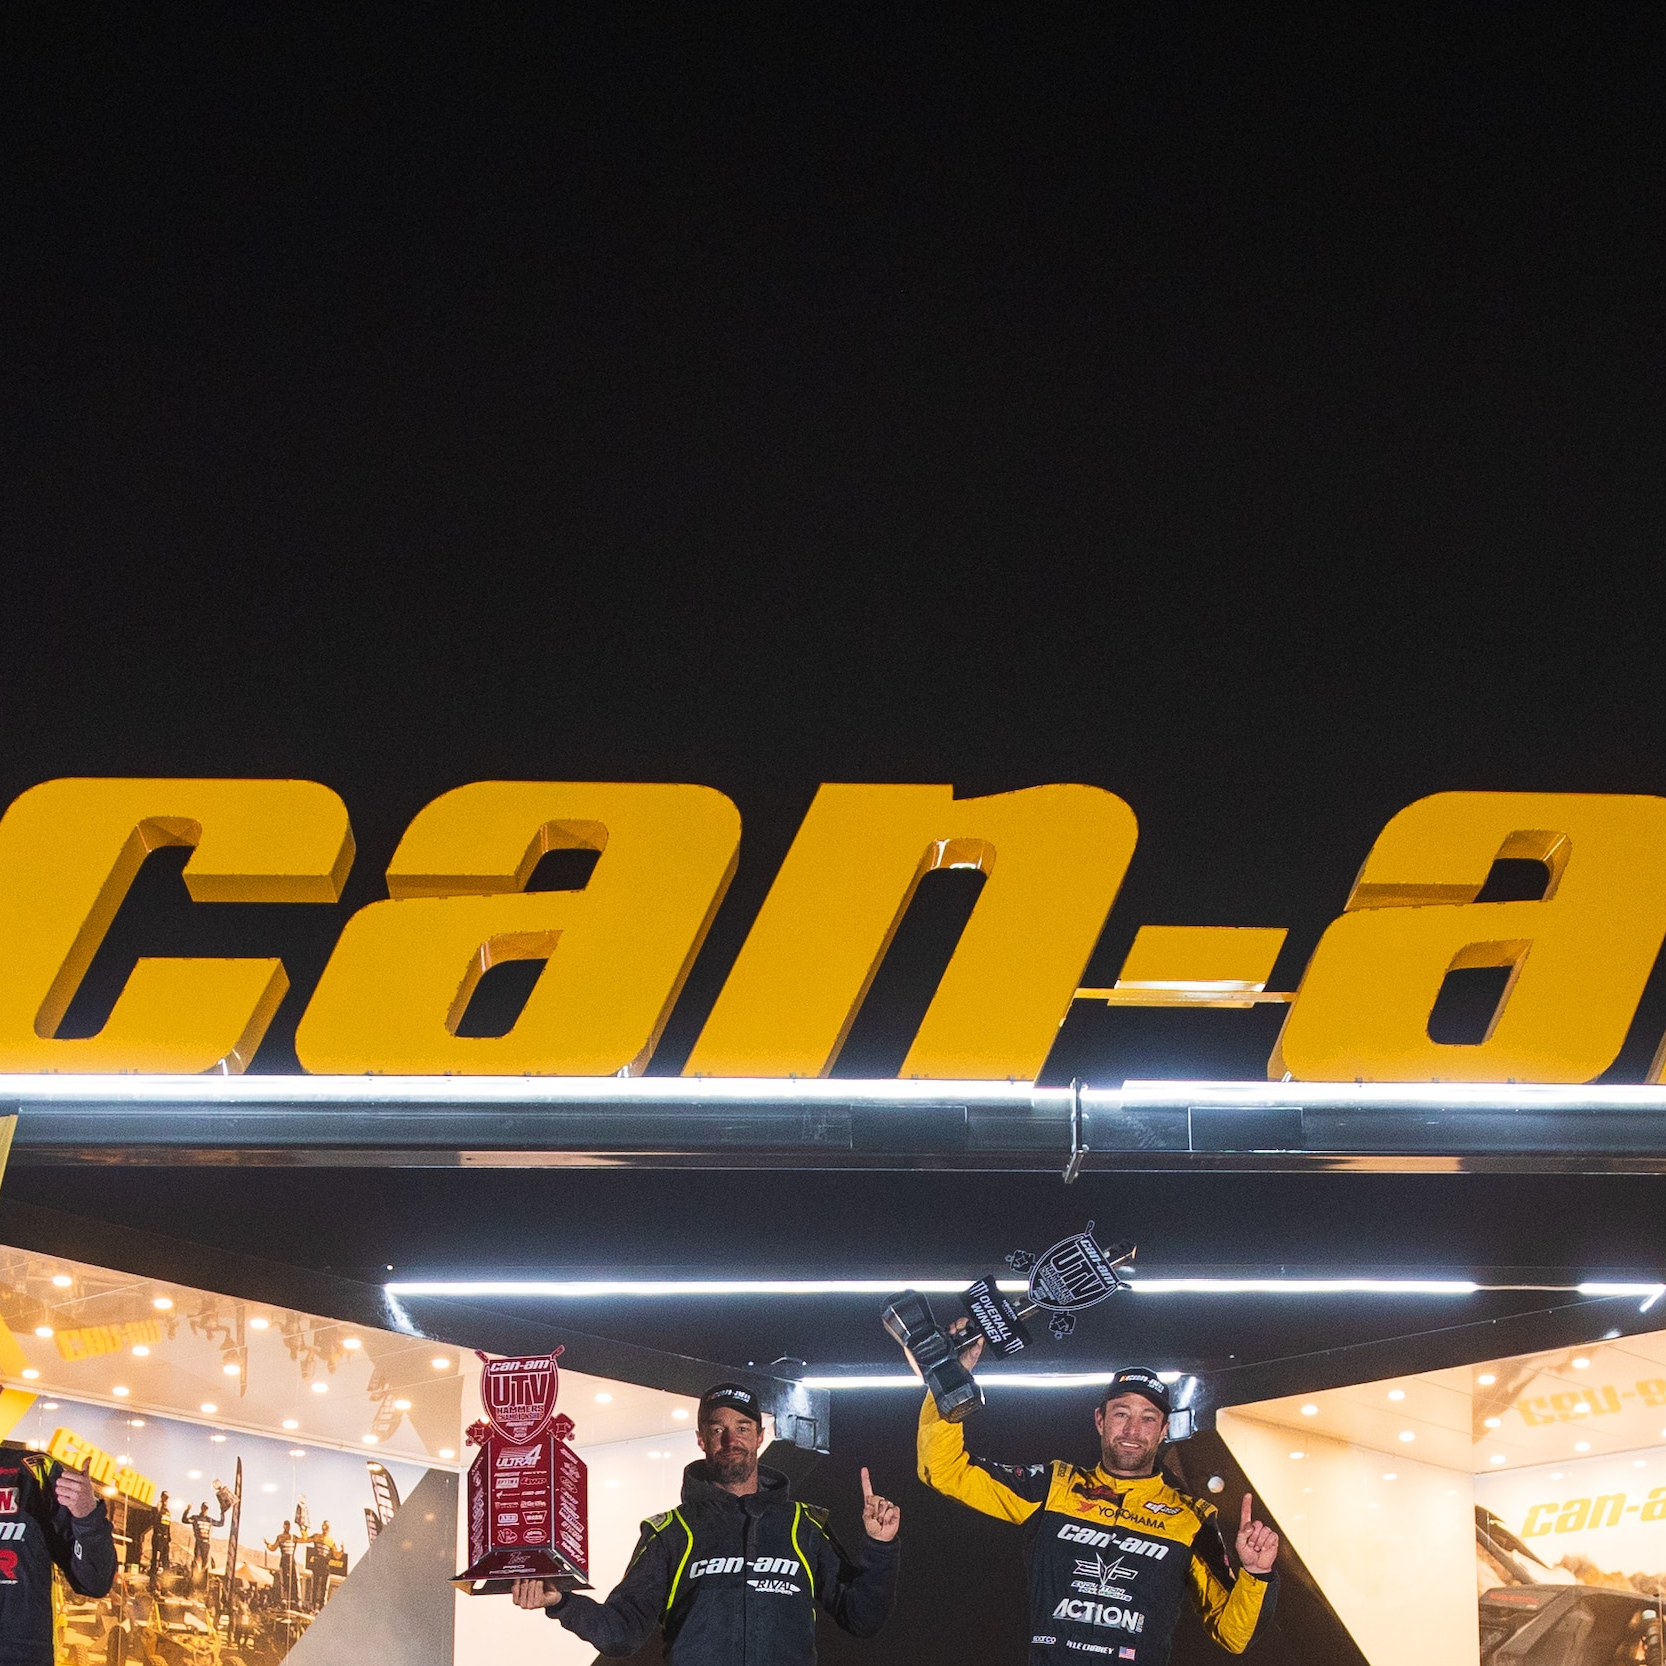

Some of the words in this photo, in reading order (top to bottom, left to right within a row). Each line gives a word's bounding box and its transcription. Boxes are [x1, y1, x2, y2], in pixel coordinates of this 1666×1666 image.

[1050, 1246, 1107, 1300] UTV
[1079, 1239, 1116, 1286] can-am
[970, 1302, 1002, 1344] WINNER
[979, 1295, 1010, 1340] OVERALL
[489, 1359, 550, 1372] can-am
[490, 1373, 550, 1408] UTV
[496, 1405, 544, 1414] HAMMERS
[1098, 1505, 1166, 1530] YOKOHAMA
[1057, 1523, 1169, 1560] can-am
[689, 1556, 800, 1579] can-am
[1052, 1598, 1139, 1632] ACTION
